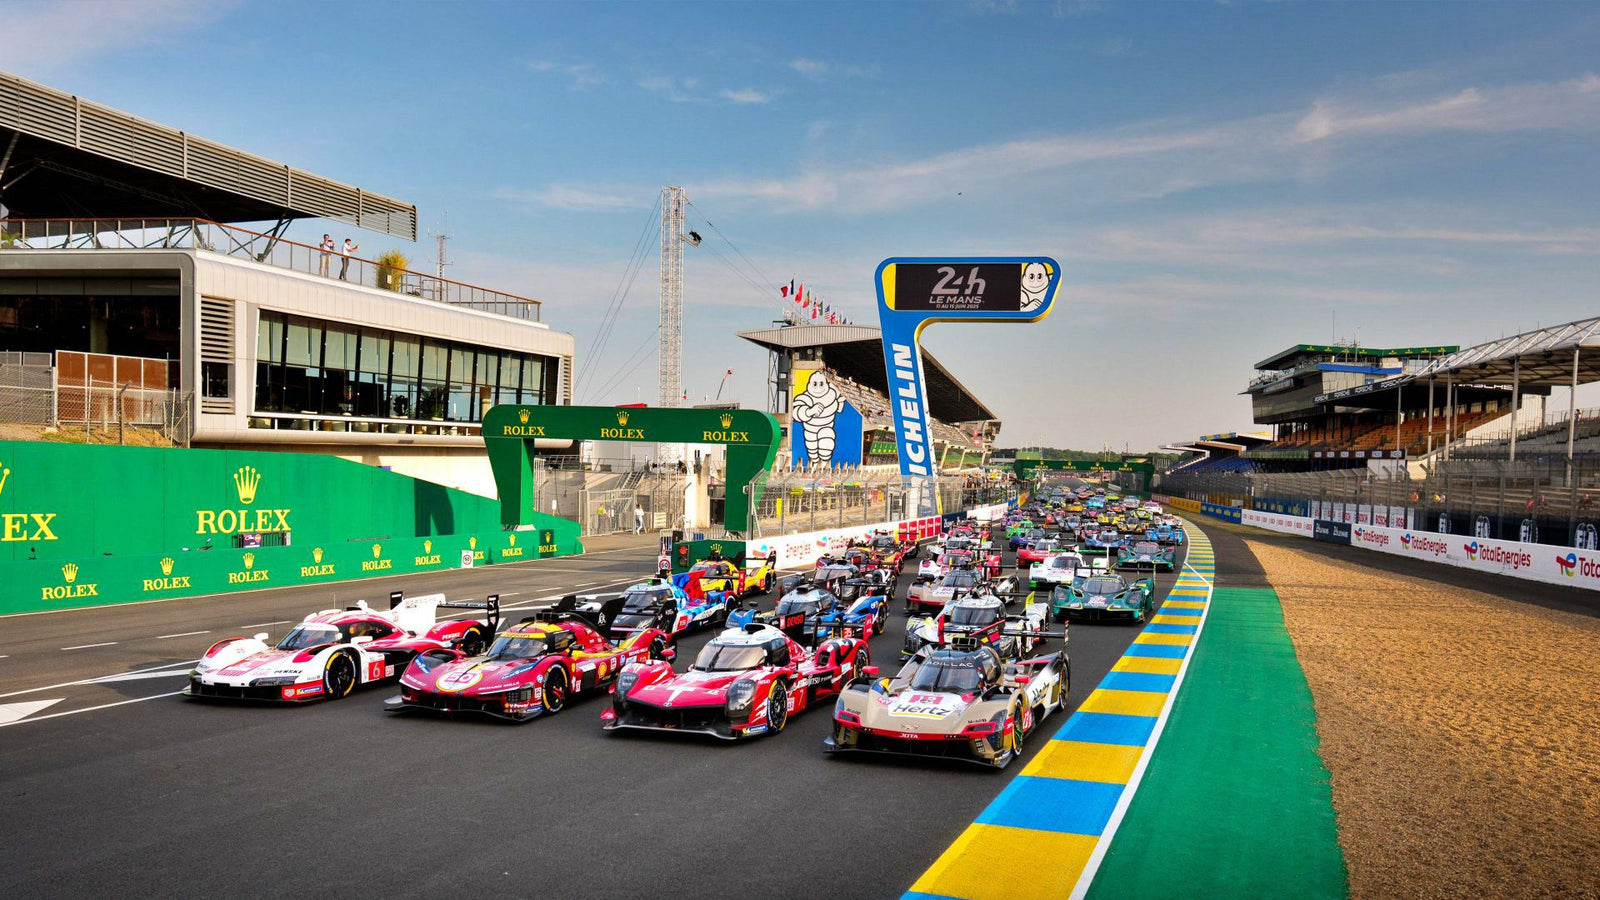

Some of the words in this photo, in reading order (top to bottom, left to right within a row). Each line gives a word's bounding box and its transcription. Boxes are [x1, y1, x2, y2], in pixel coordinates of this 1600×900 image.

[931, 266, 986, 295] 24h
[929, 296, 944, 304] LE
[946, 296, 982, 304] MANS
[503, 425, 545, 436] ROLEX
[601, 428, 644, 439] ROLEX
[703, 430, 749, 442] ROLEX
[196, 508, 291, 534] ROLEX
[1362, 530, 1389, 547] TotalEnergies
[502, 547, 523, 557] ROLEX
[538, 544, 558, 553] ROLEX
[1411, 535, 1447, 557] TotalEnergies
[415, 554, 441, 566] ROLEX
[1479, 544, 1531, 570] TotalEnergies
[301, 564, 335, 577] ROLEX
[361, 559, 392, 571] ROLEX
[228, 570, 270, 584] ROLEX
[143, 576, 191, 591] ROLEX
[41, 584, 98, 600] ROLEX
[787, 615, 804, 627] DENSO
[923, 658, 974, 668] ADILLAC
[373, 662, 381, 678] 6
[894, 704, 951, 716] Hertz
